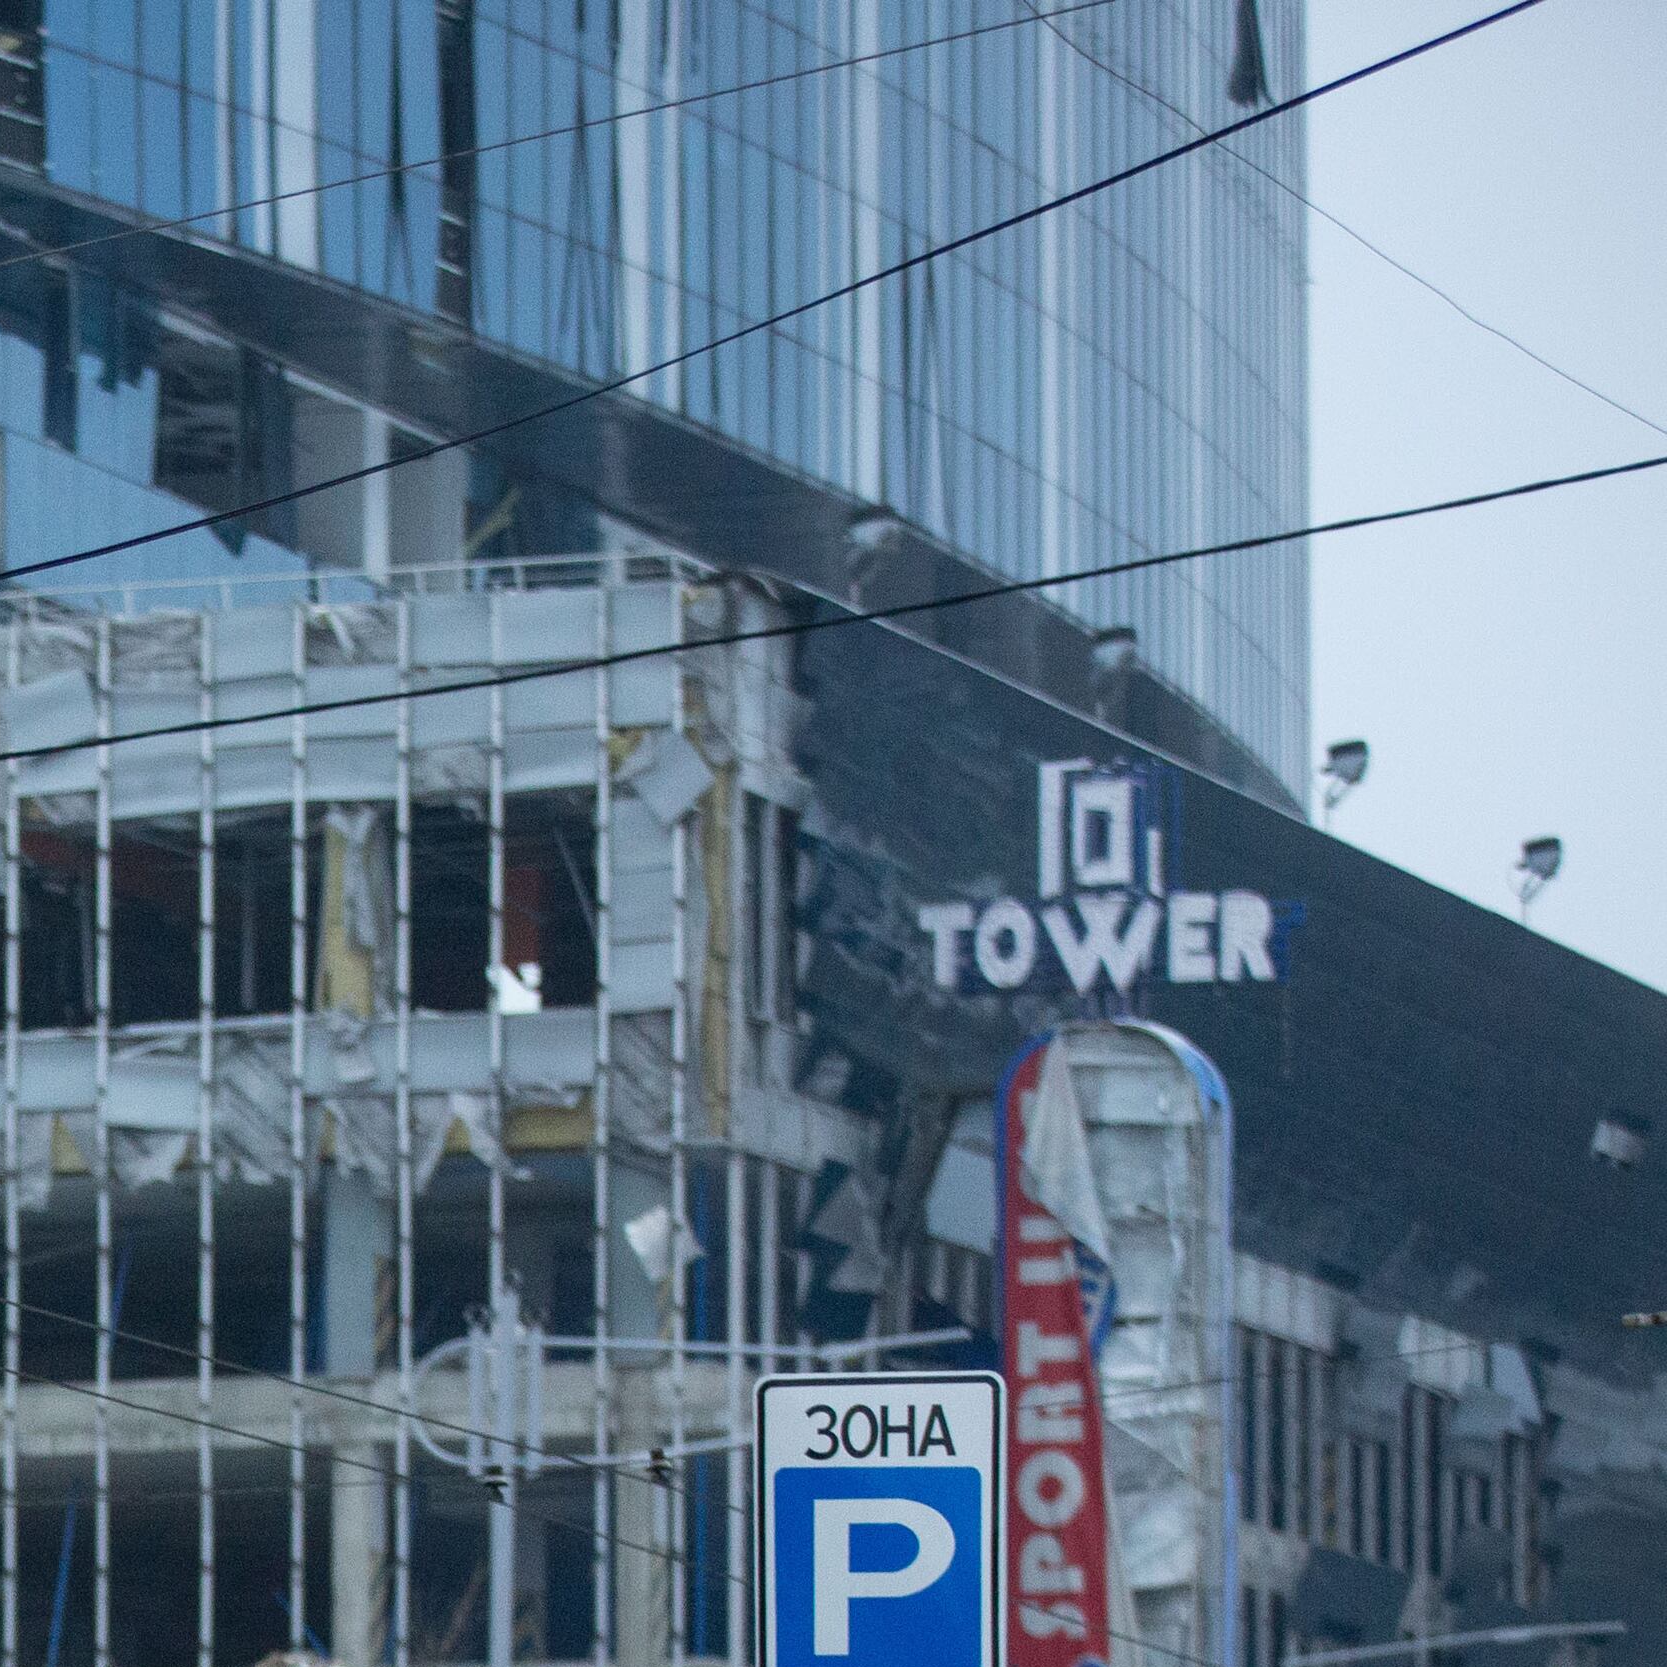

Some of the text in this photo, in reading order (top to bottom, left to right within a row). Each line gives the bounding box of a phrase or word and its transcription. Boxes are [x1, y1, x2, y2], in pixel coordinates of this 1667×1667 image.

[918, 889, 1276, 998] TOWER
[804, 1404, 956, 1460] ЗОНА
[1017, 1319, 1086, 1641] SPORT
[813, 1498, 956, 1656] P
